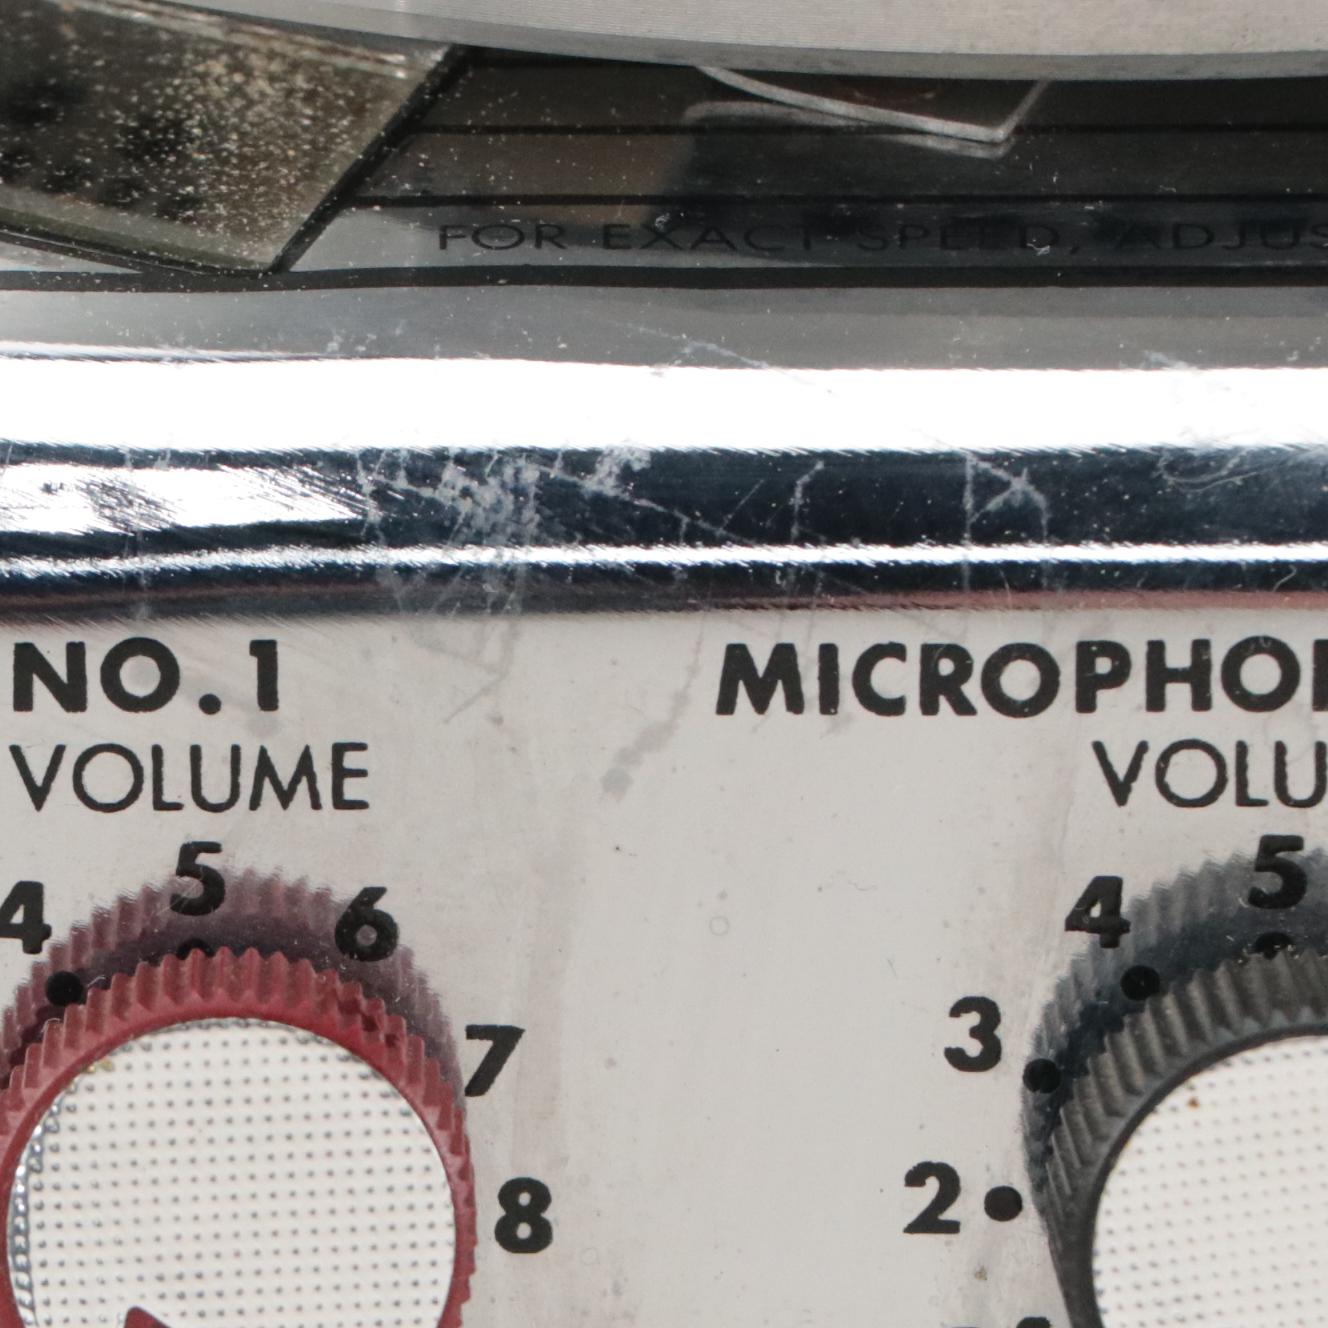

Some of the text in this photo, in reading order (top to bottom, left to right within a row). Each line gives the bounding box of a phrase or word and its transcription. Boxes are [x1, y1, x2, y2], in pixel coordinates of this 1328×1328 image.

[439, 223, 564, 251] FOR
[602, 223, 829, 253] EXACT
[716, 636, 1328, 718] MICROPHO
[9, 741, 371, 813] VOLUME
[1091, 738, 1328, 808] VOLU
[170, 841, 227, 916] 5
[1247, 834, 1308, 910] 5
[334, 887, 400, 962] 6
[1064, 875, 1131, 949] 4
[465, 1024, 525, 1098] 7
[943, 996, 1002, 1073] 3
[494, 1177, 553, 1254] 8
[902, 1160, 961, 1234] 2
